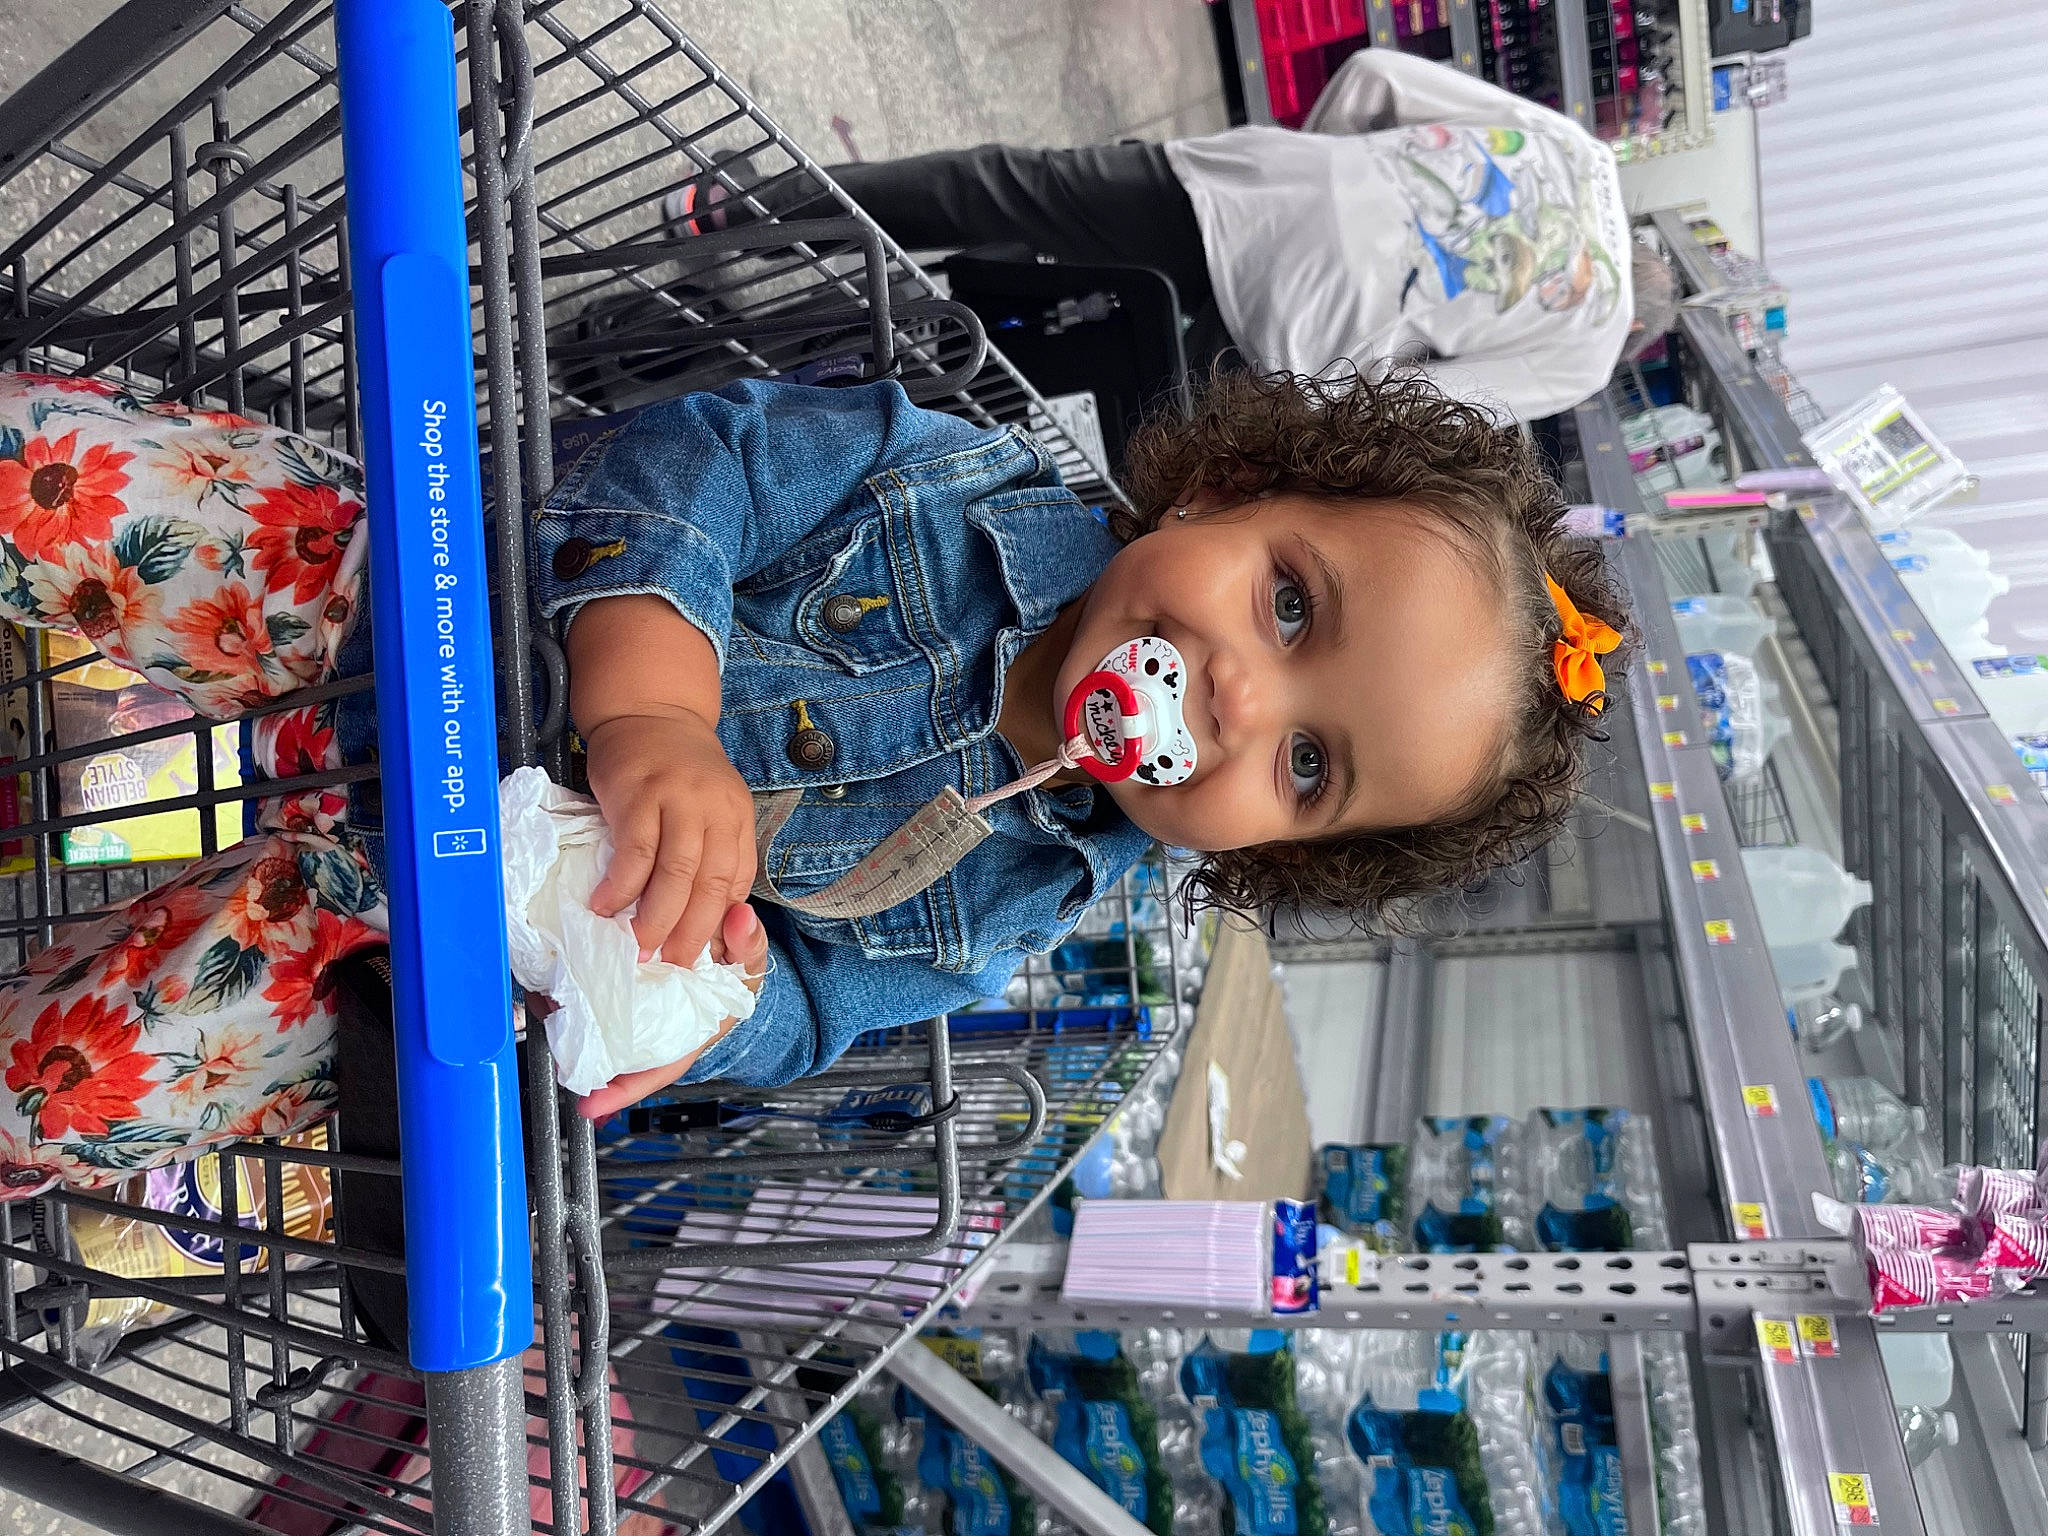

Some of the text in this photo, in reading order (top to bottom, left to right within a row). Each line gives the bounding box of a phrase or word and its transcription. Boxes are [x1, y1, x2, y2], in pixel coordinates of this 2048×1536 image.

[419, 399, 466, 814] Shop the store & more with our app.
[1128, 643, 1138, 670] NUK
[87, 761, 135, 786] STYLE
[83, 780, 147, 808] BELGIAN
